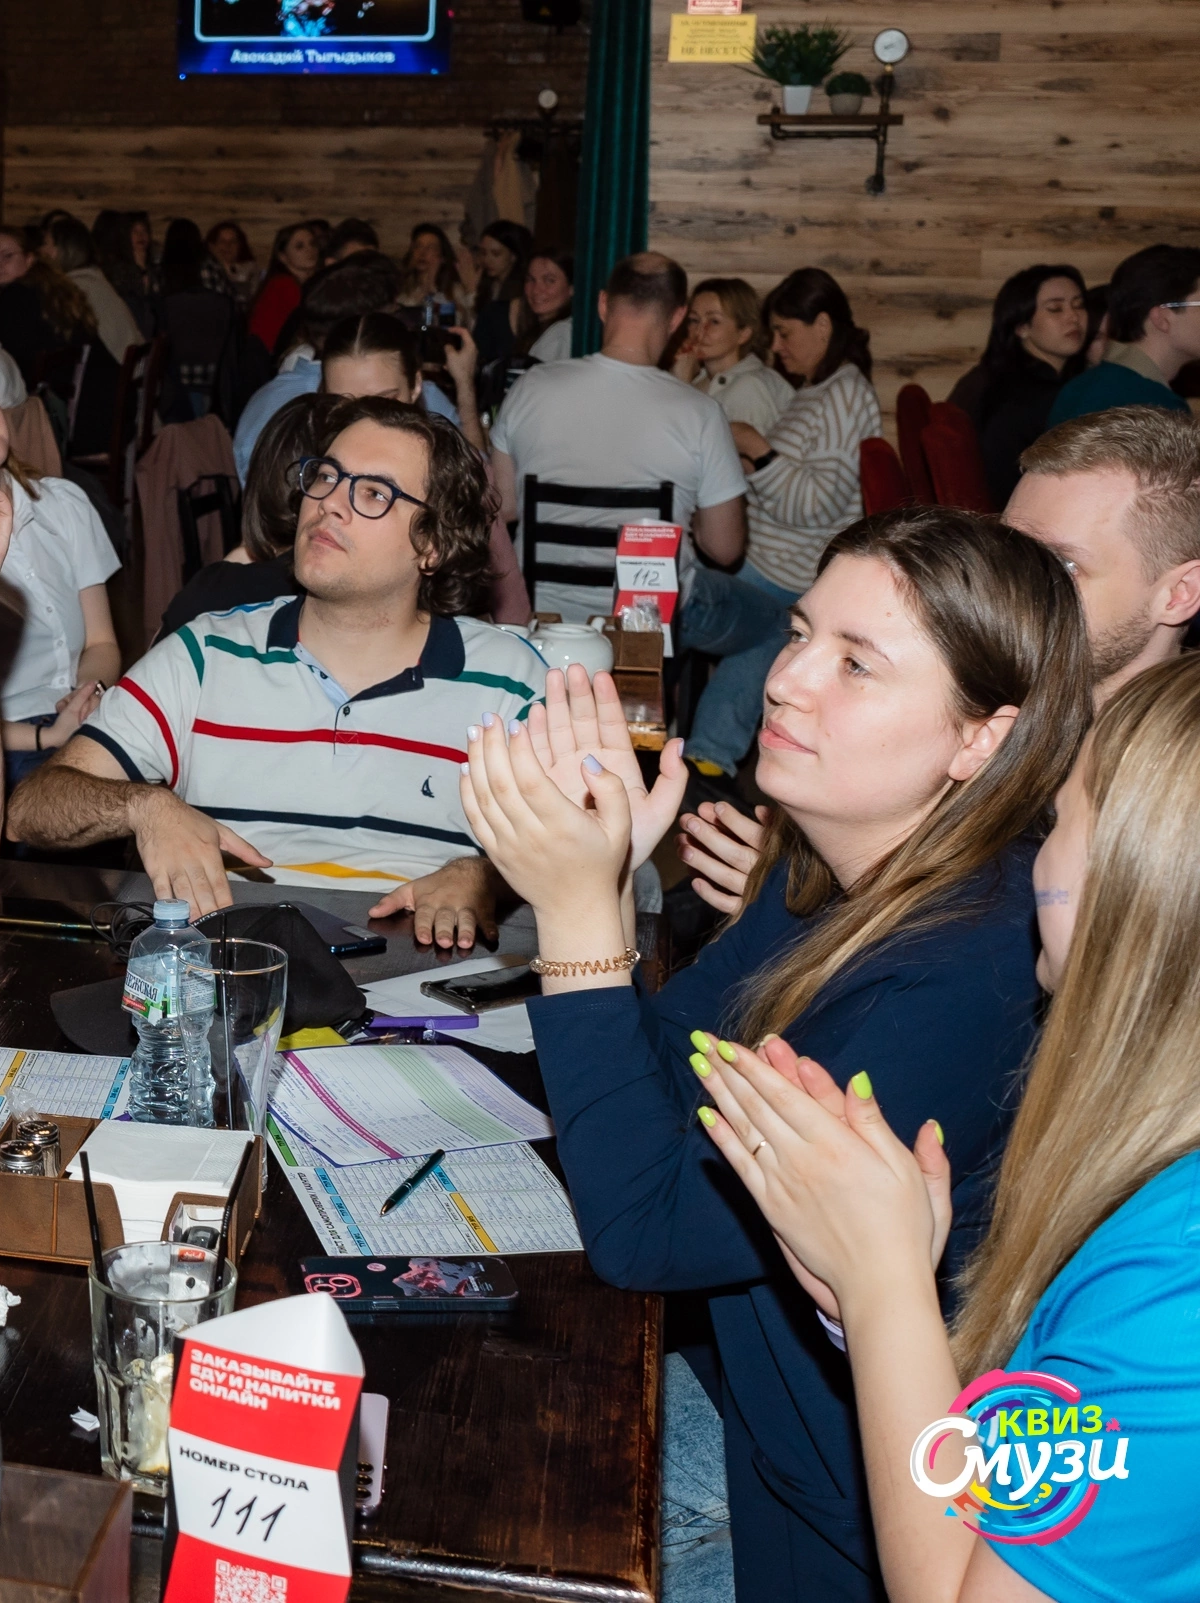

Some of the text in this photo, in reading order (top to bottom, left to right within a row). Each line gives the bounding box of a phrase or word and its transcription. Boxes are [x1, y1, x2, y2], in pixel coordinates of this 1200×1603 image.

[632, 567, 661, 587] 112
[189, 1362, 342, 1411] ЕДУ И НАПИТКИ
[189, 1377, 269, 1411] ОНЛАЙН
[190, 1348, 336, 1395] ЗАКАЗЫВАЙТЕ
[179, 1445, 310, 1492] НОМЕР СТОЛА
[209, 1486, 287, 1542] 111
